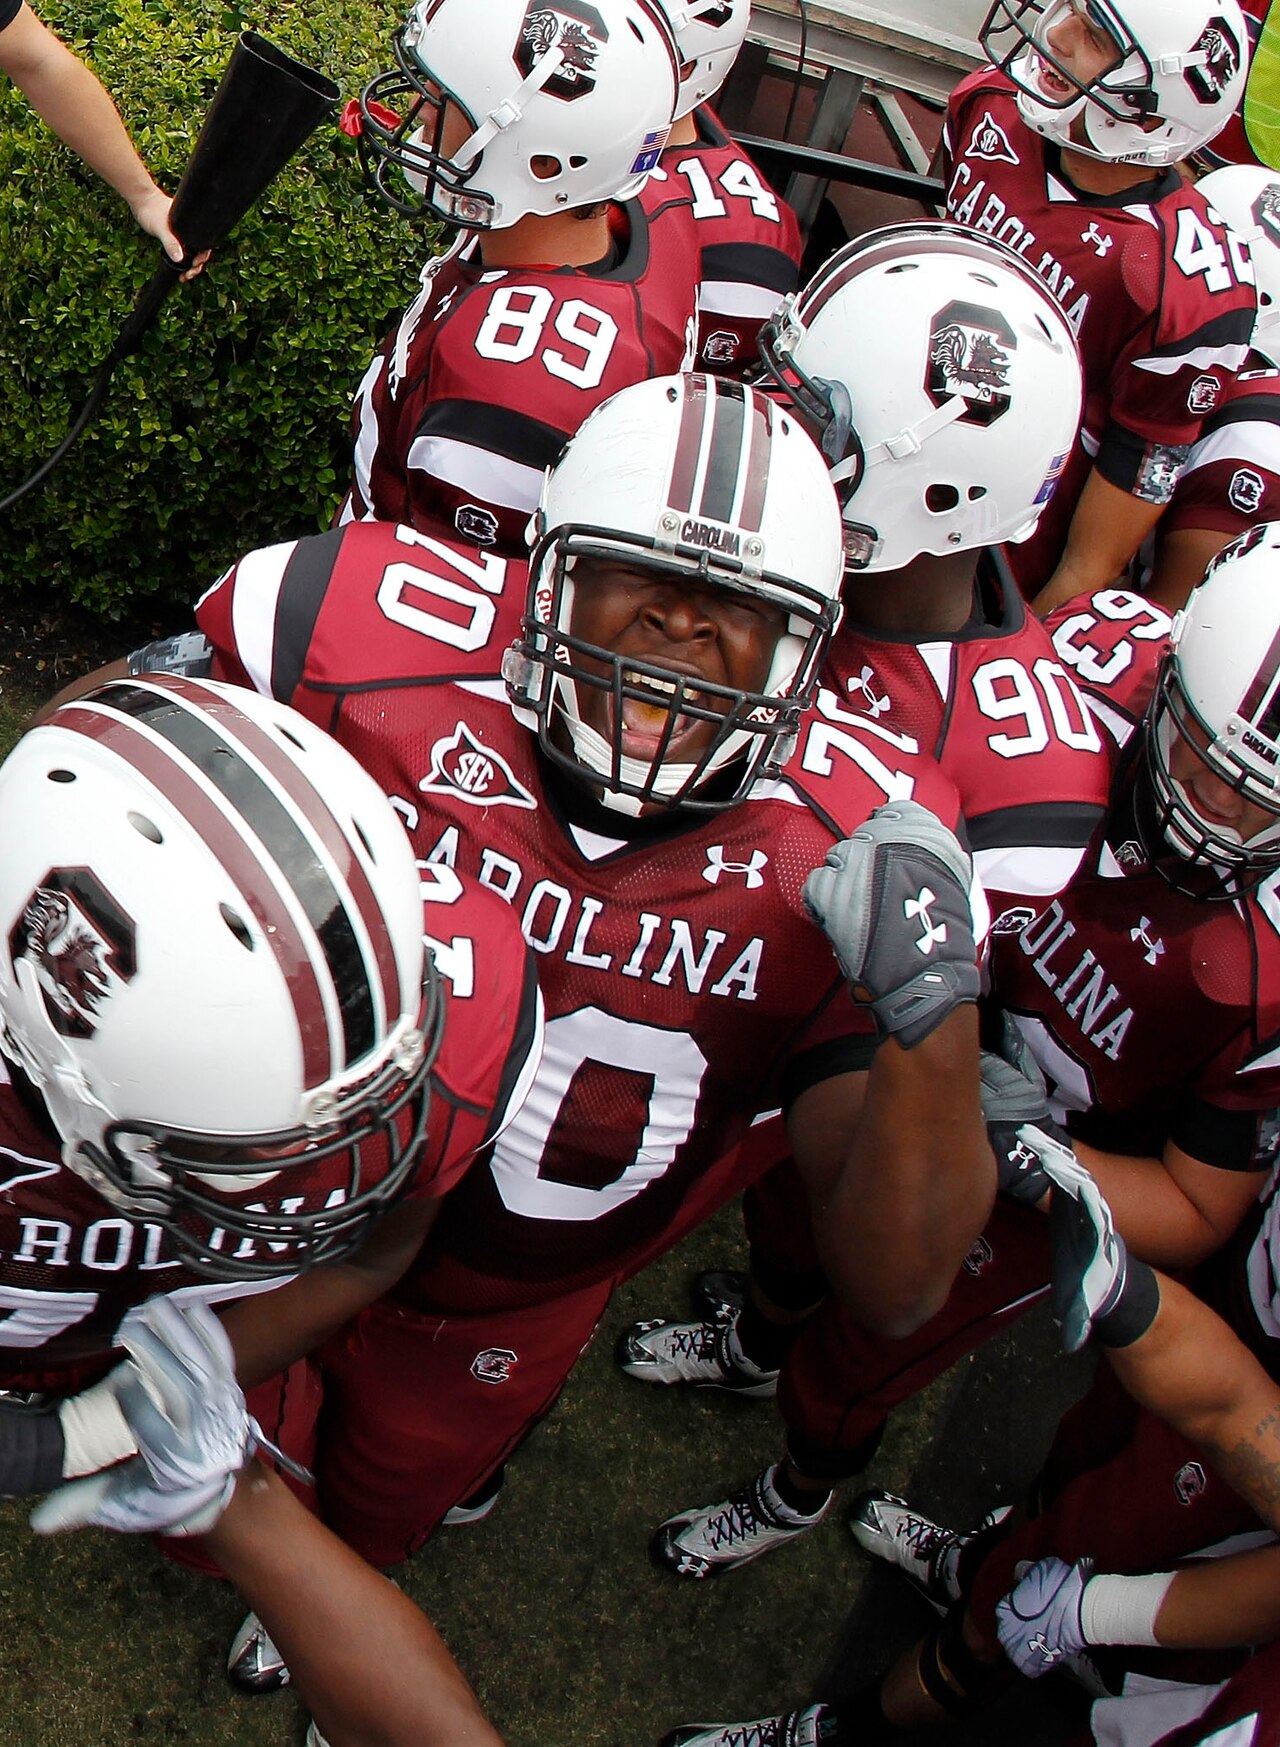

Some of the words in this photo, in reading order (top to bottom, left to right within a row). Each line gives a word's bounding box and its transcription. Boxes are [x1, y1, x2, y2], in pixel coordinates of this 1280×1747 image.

[677, 157, 781, 223] 14
[474, 284, 619, 388] 89
[681, 519, 740, 557] CAROLINA
[376, 523, 507, 653] 70
[971, 657, 1102, 758] 90
[453, 752, 495, 793] SEC
